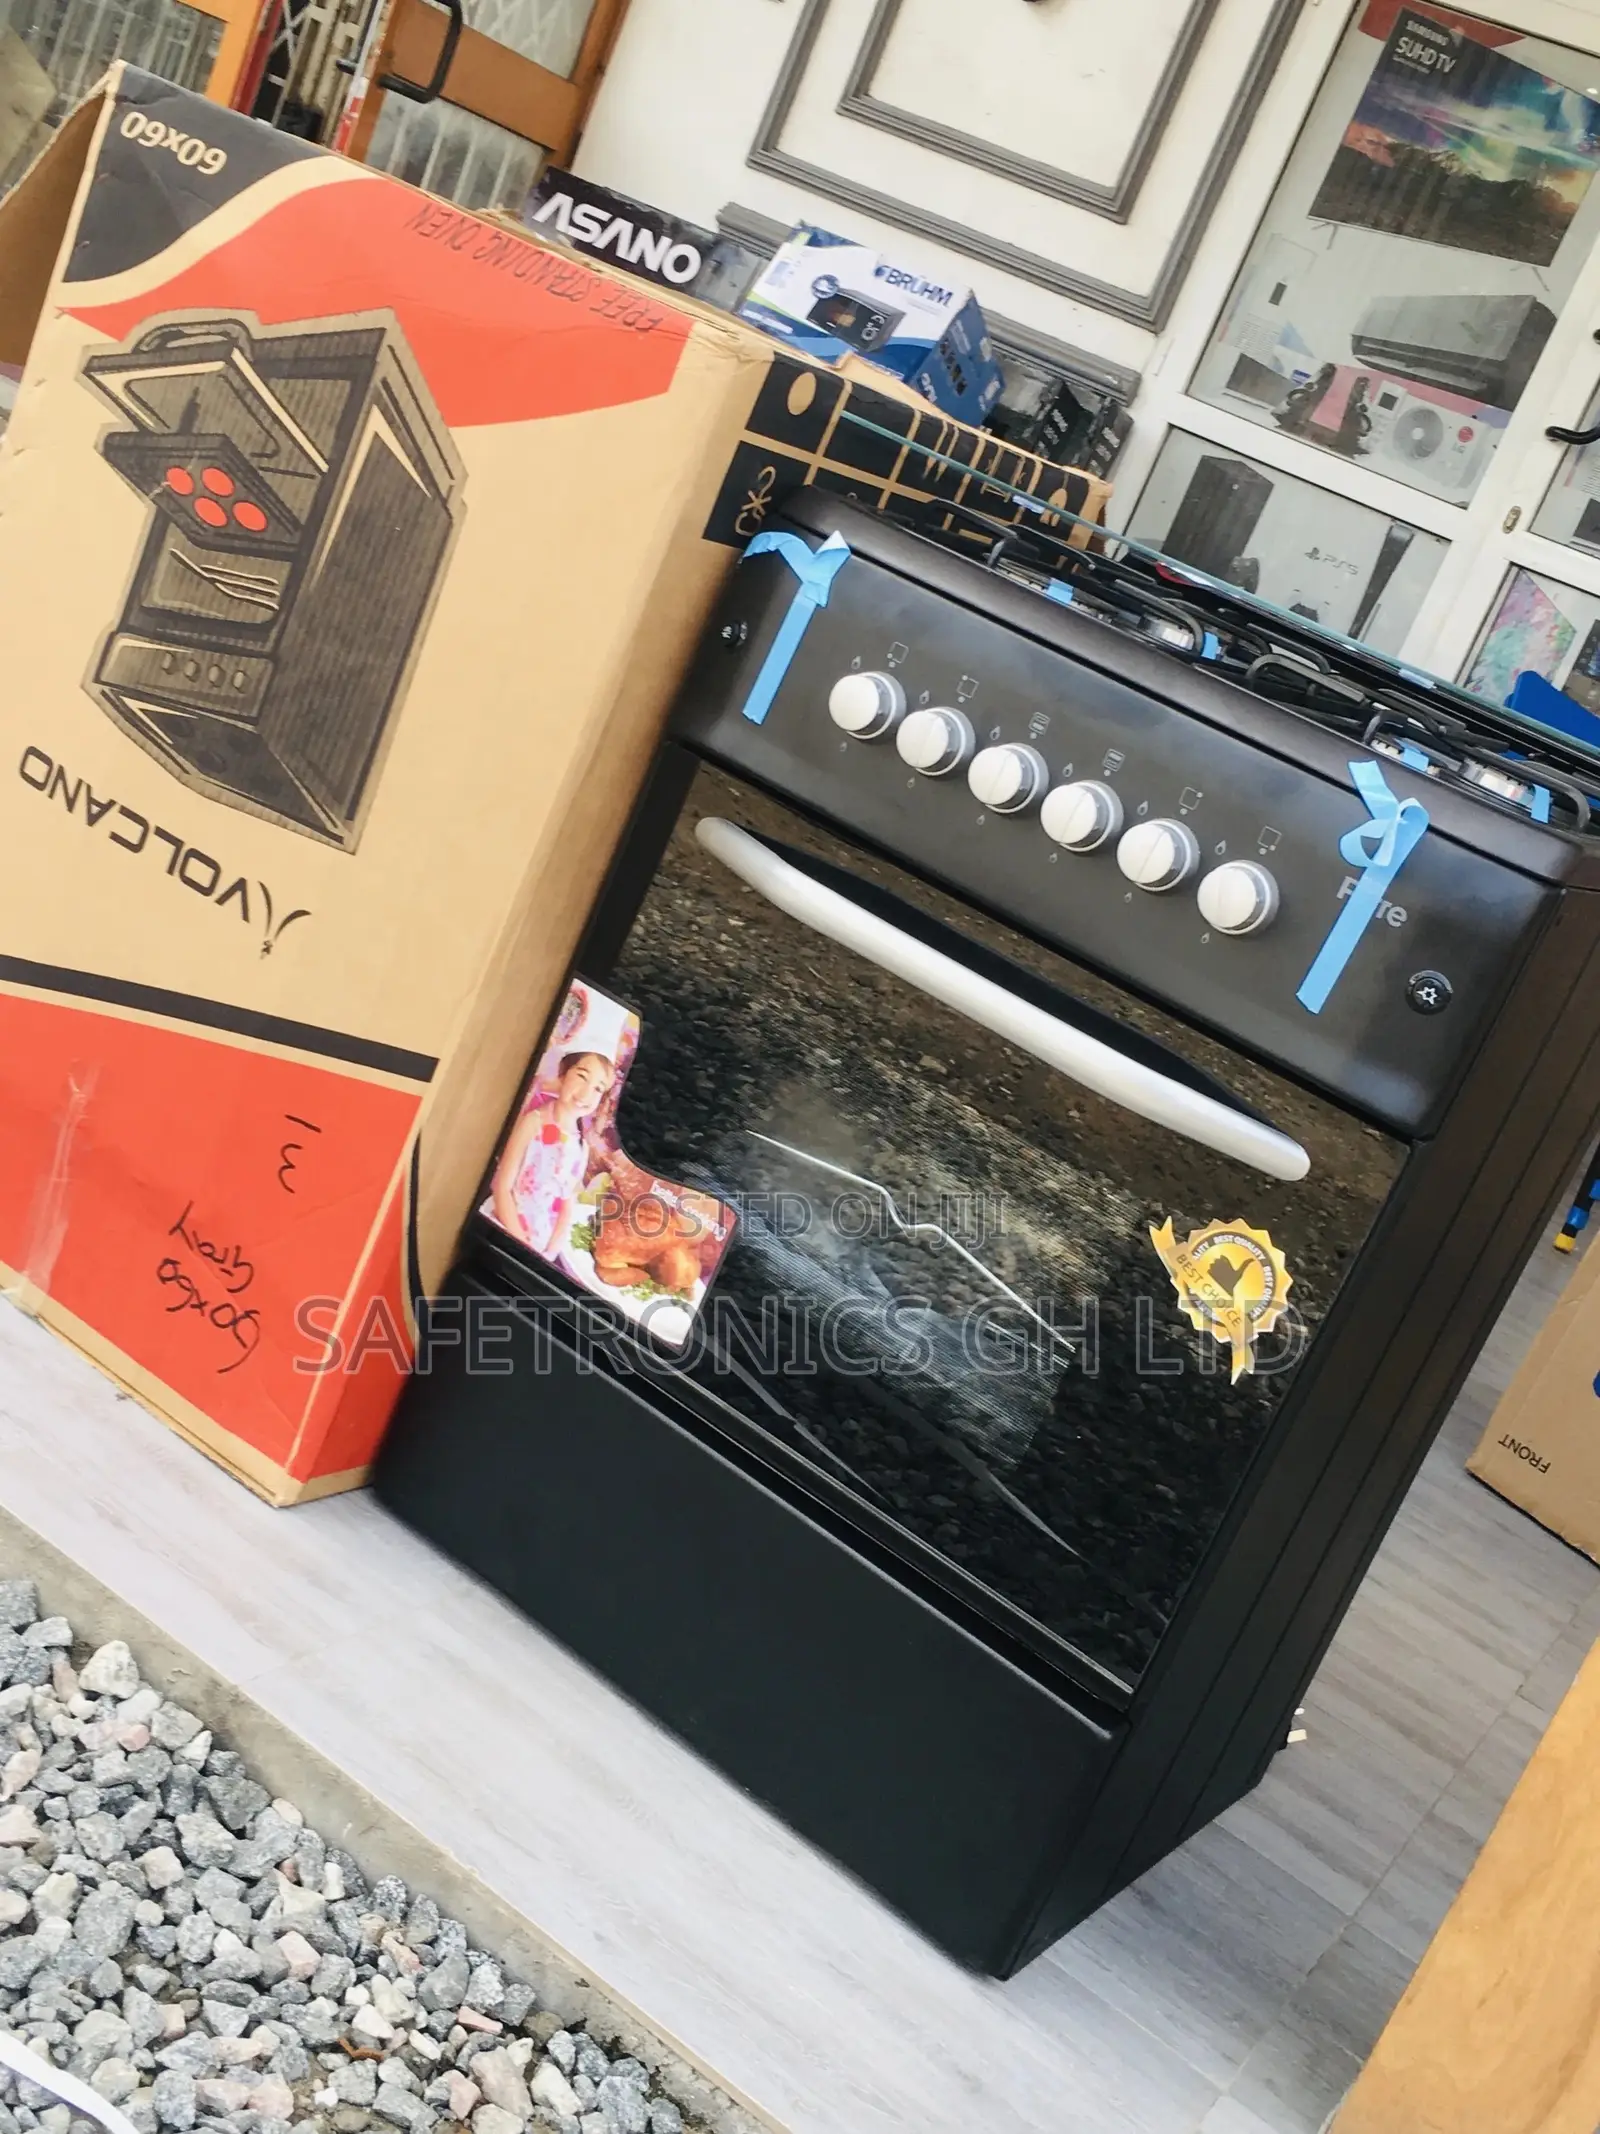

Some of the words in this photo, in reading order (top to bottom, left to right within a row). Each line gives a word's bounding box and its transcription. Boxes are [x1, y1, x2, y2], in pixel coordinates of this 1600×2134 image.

[1436, 53, 1457, 73] TV
[403, 202, 482, 251] OVEN
[532, 191, 702, 284] ASANO
[472, 233, 600, 302] STANDING
[588, 287, 664, 333] FREE
[1322, 553, 1359, 576] PS5
[19, 745, 251, 924] VOLCANO
[1176, 1253, 1204, 1284] BEST
[1201, 1282, 1242, 1328] CHOICE
[1497, 1433, 1552, 1474] FRONT
